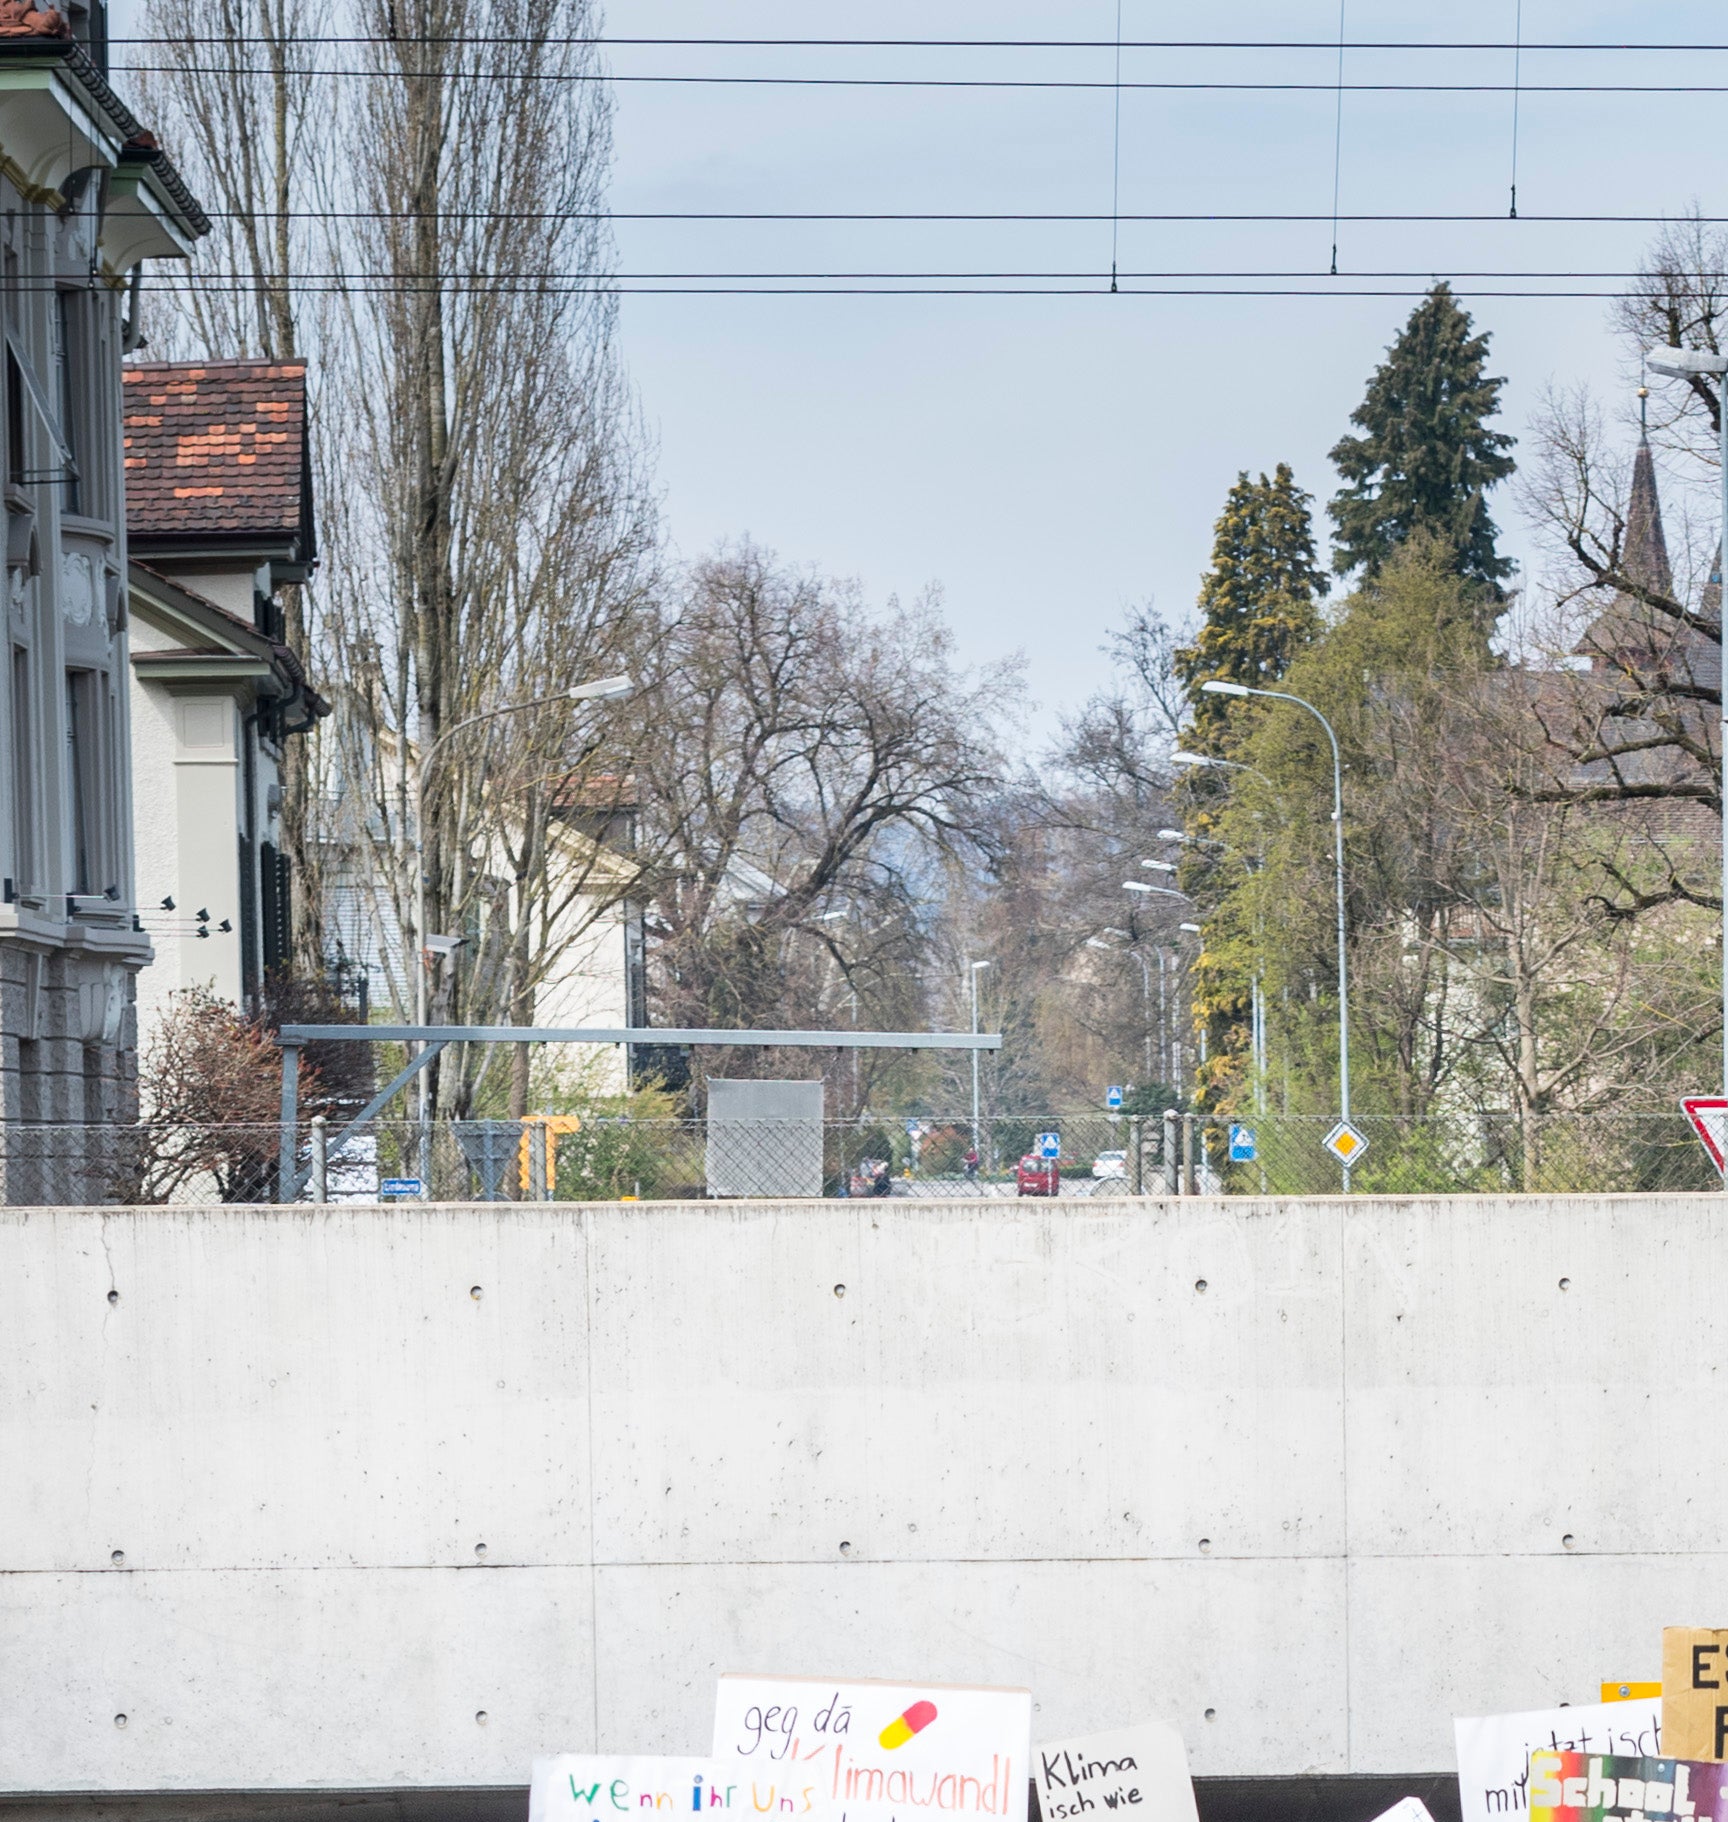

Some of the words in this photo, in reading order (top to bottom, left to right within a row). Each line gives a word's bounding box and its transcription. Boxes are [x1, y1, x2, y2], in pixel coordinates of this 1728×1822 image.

[1042, 1750, 1138, 1790] Klima
[692, 1774, 738, 1811] ihr
[1047, 1791, 1095, 1819] isch
[1104, 1786, 1143, 1810] wie
